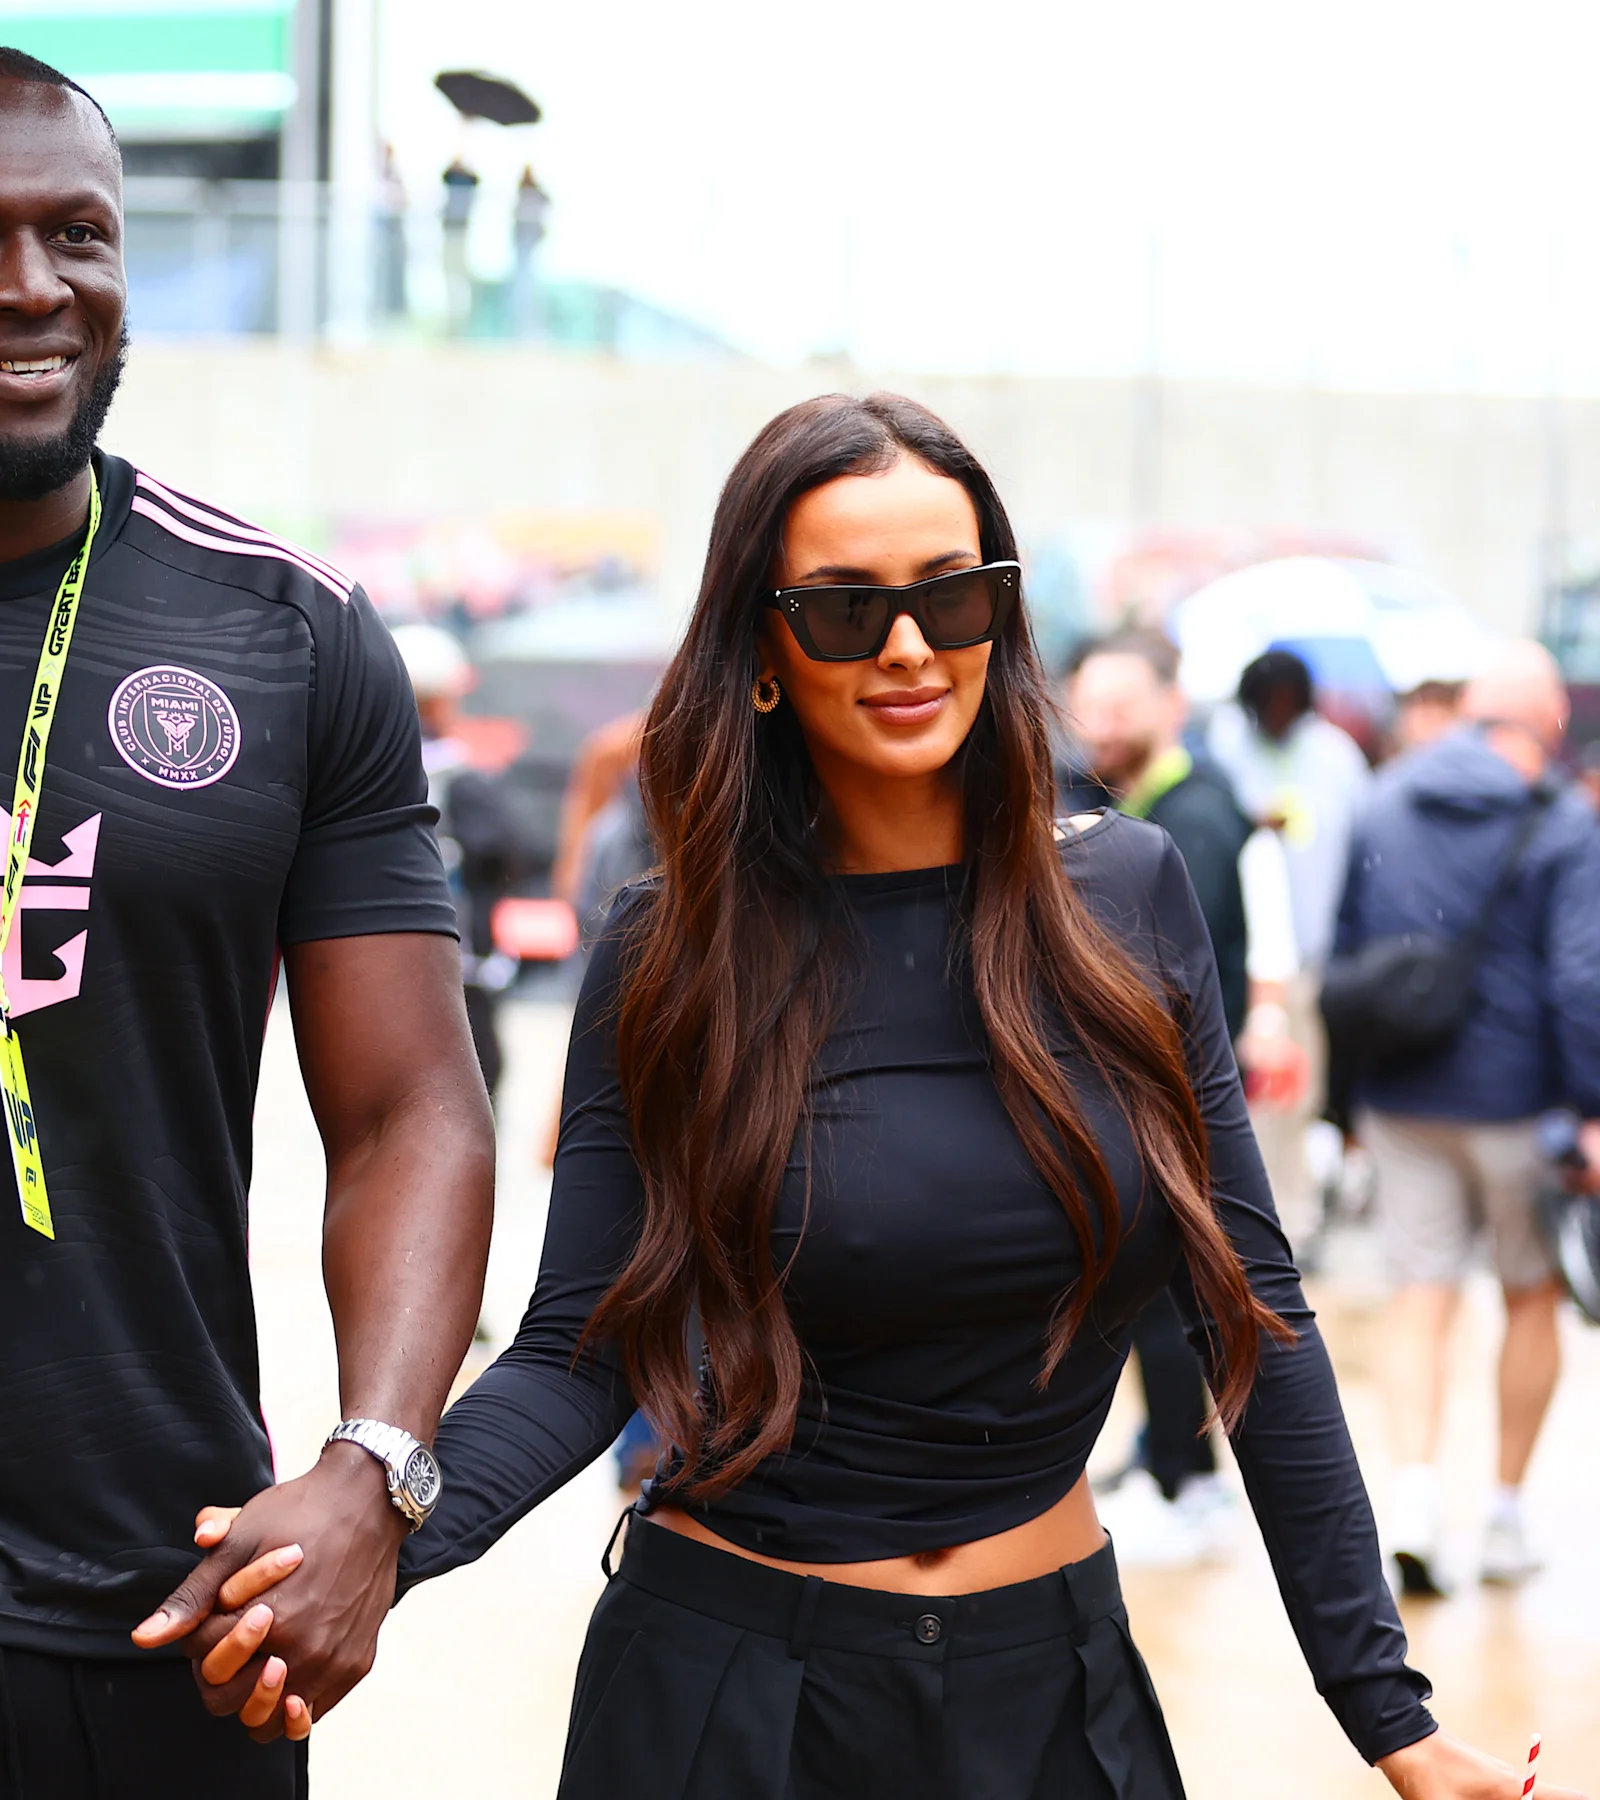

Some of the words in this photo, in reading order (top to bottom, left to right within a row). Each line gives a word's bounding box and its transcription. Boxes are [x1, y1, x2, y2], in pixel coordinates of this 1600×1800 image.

[32, 683, 52, 719] VIP
[48, 589, 75, 656] GREAT
[118, 674, 211, 714] INTERNACIONAL
[150, 697, 198, 711] MIAMI
[212, 699, 226, 714] DE
[118, 720, 136, 751] CLUB
[158, 766, 198, 780] MMXX
